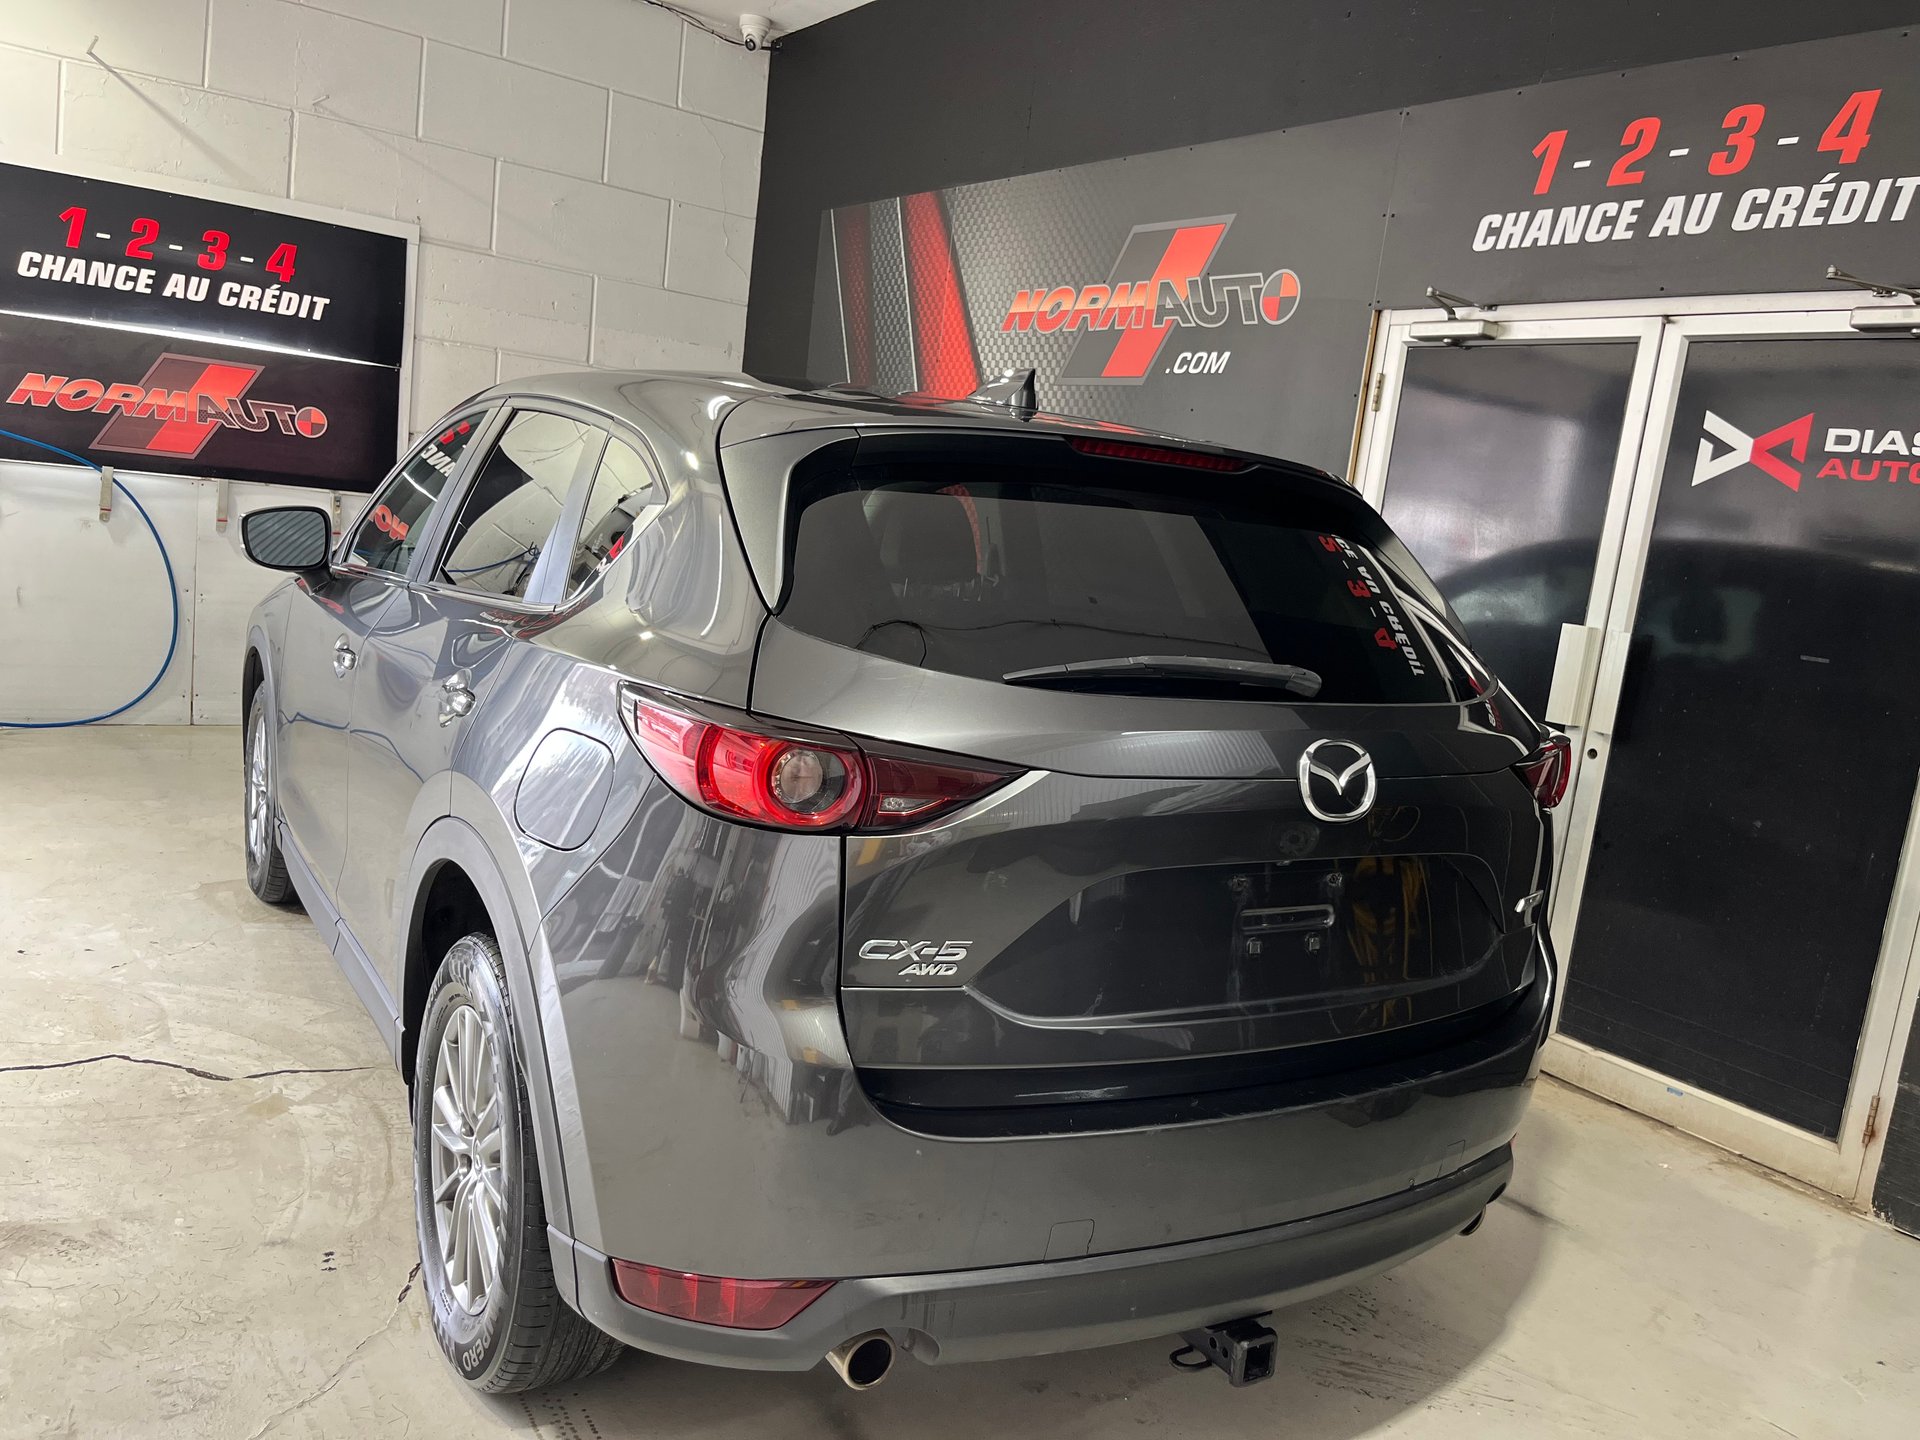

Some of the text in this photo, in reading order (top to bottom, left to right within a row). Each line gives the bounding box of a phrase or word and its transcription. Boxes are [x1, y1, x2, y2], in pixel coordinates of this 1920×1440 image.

[1531, 129, 1568, 195] 1
[1605, 116, 1661, 187] 2
[1707, 103, 1766, 176] 3
[1816, 89, 1883, 165] 4
[58, 206, 87, 249] 1
[125, 217, 161, 261] 2
[197, 230, 230, 271] 3
[265, 243, 298, 283] 4
[1471, 171, 1920, 252] CHANCE AU CRÉDIT
[16, 251, 331, 321] CHANCE AU CRÉDIT
[1164, 351, 1231, 375] .COM
[859, 939, 973, 961] CX-5
[898, 963, 958, 976] AWD
